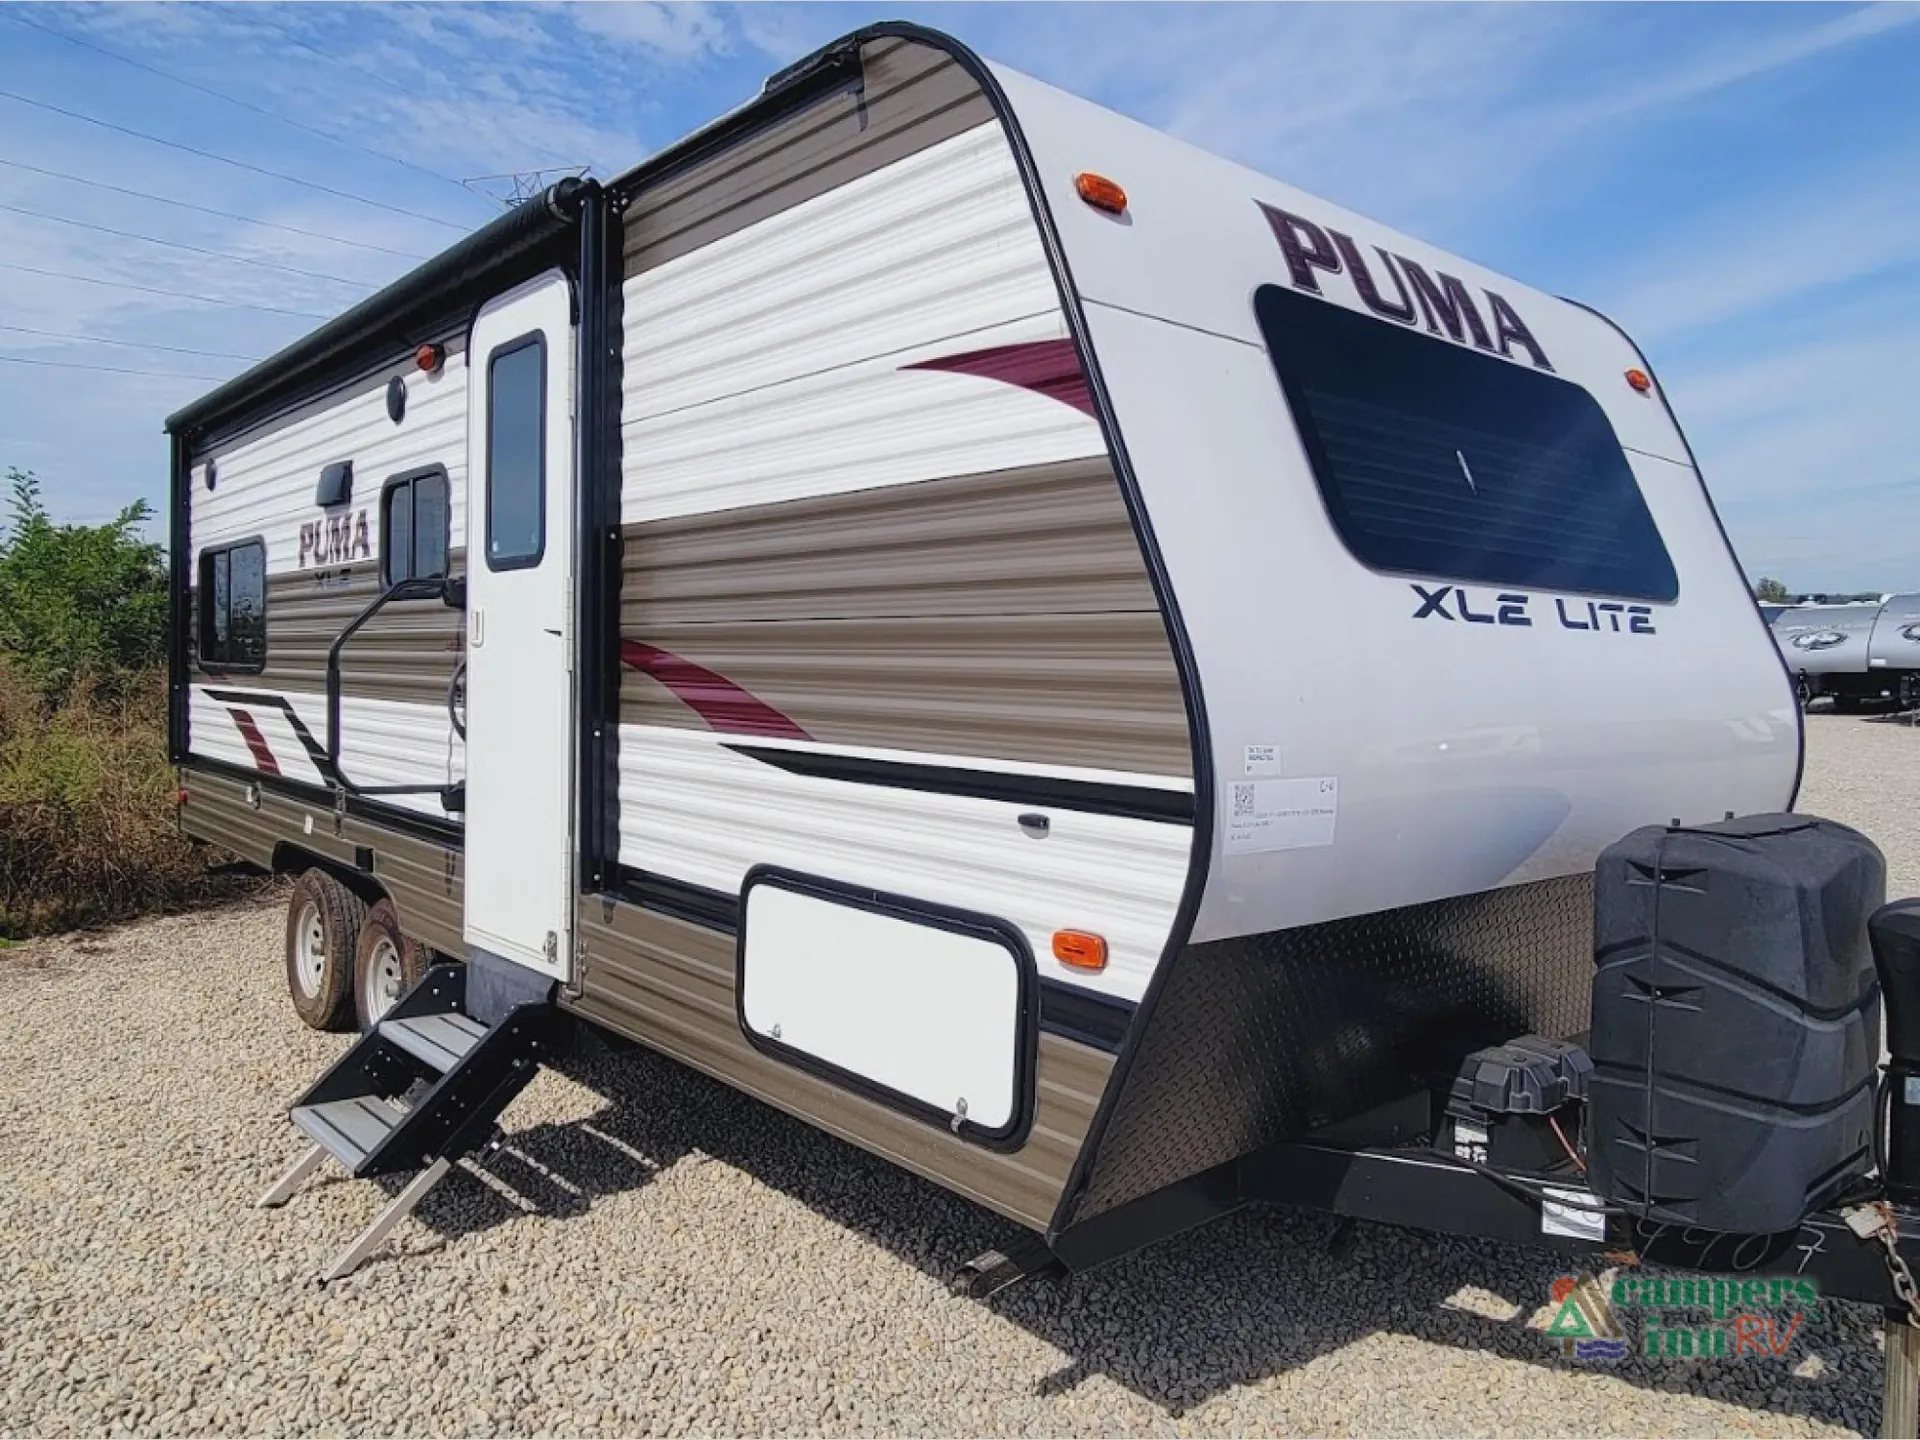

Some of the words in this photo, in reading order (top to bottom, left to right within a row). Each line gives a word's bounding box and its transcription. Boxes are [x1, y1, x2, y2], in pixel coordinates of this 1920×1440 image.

[1252, 197, 1557, 374] PUMA
[299, 508, 371, 567] PUMA
[1409, 584, 1533, 627] XLE
[1555, 598, 1657, 635] LITE
